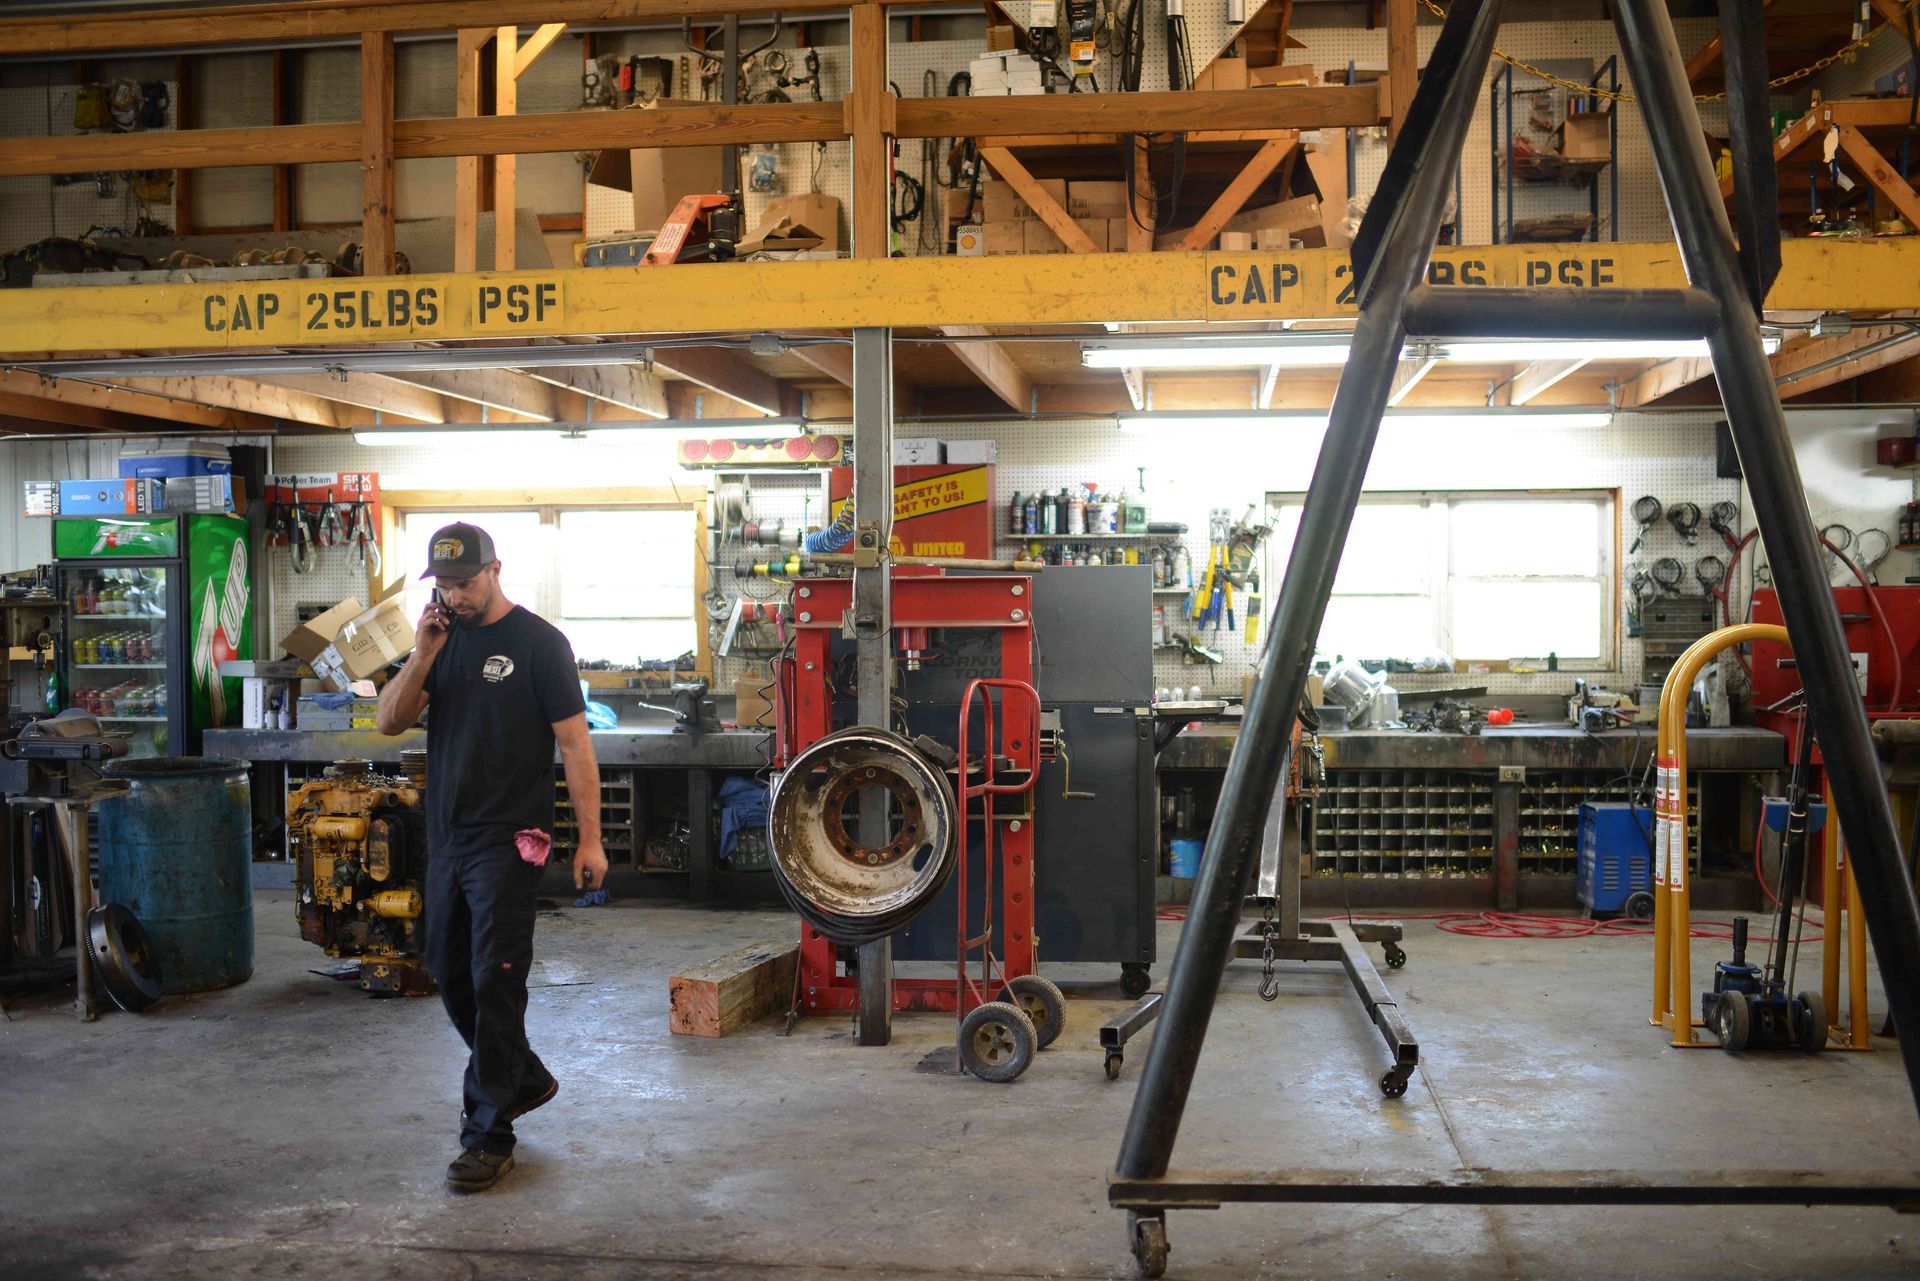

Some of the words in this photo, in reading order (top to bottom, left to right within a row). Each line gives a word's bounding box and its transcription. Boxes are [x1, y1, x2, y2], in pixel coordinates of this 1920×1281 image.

[1211, 263, 1298, 305] CAP
[1335, 260, 1487, 305] 2BS
[1527, 259, 1614, 287] PSF
[204, 293, 280, 332] CAP
[306, 287, 438, 330] 25LBS
[478, 283, 557, 324] PSF
[309, 476, 332, 484] Team
[894, 484, 943, 504] SAFETY
[946, 480, 959, 491] IS
[923, 496, 940, 508] TO
[943, 491, 965, 504] US!
[137, 494, 145, 512] LED
[913, 542, 965, 556] UNITED
